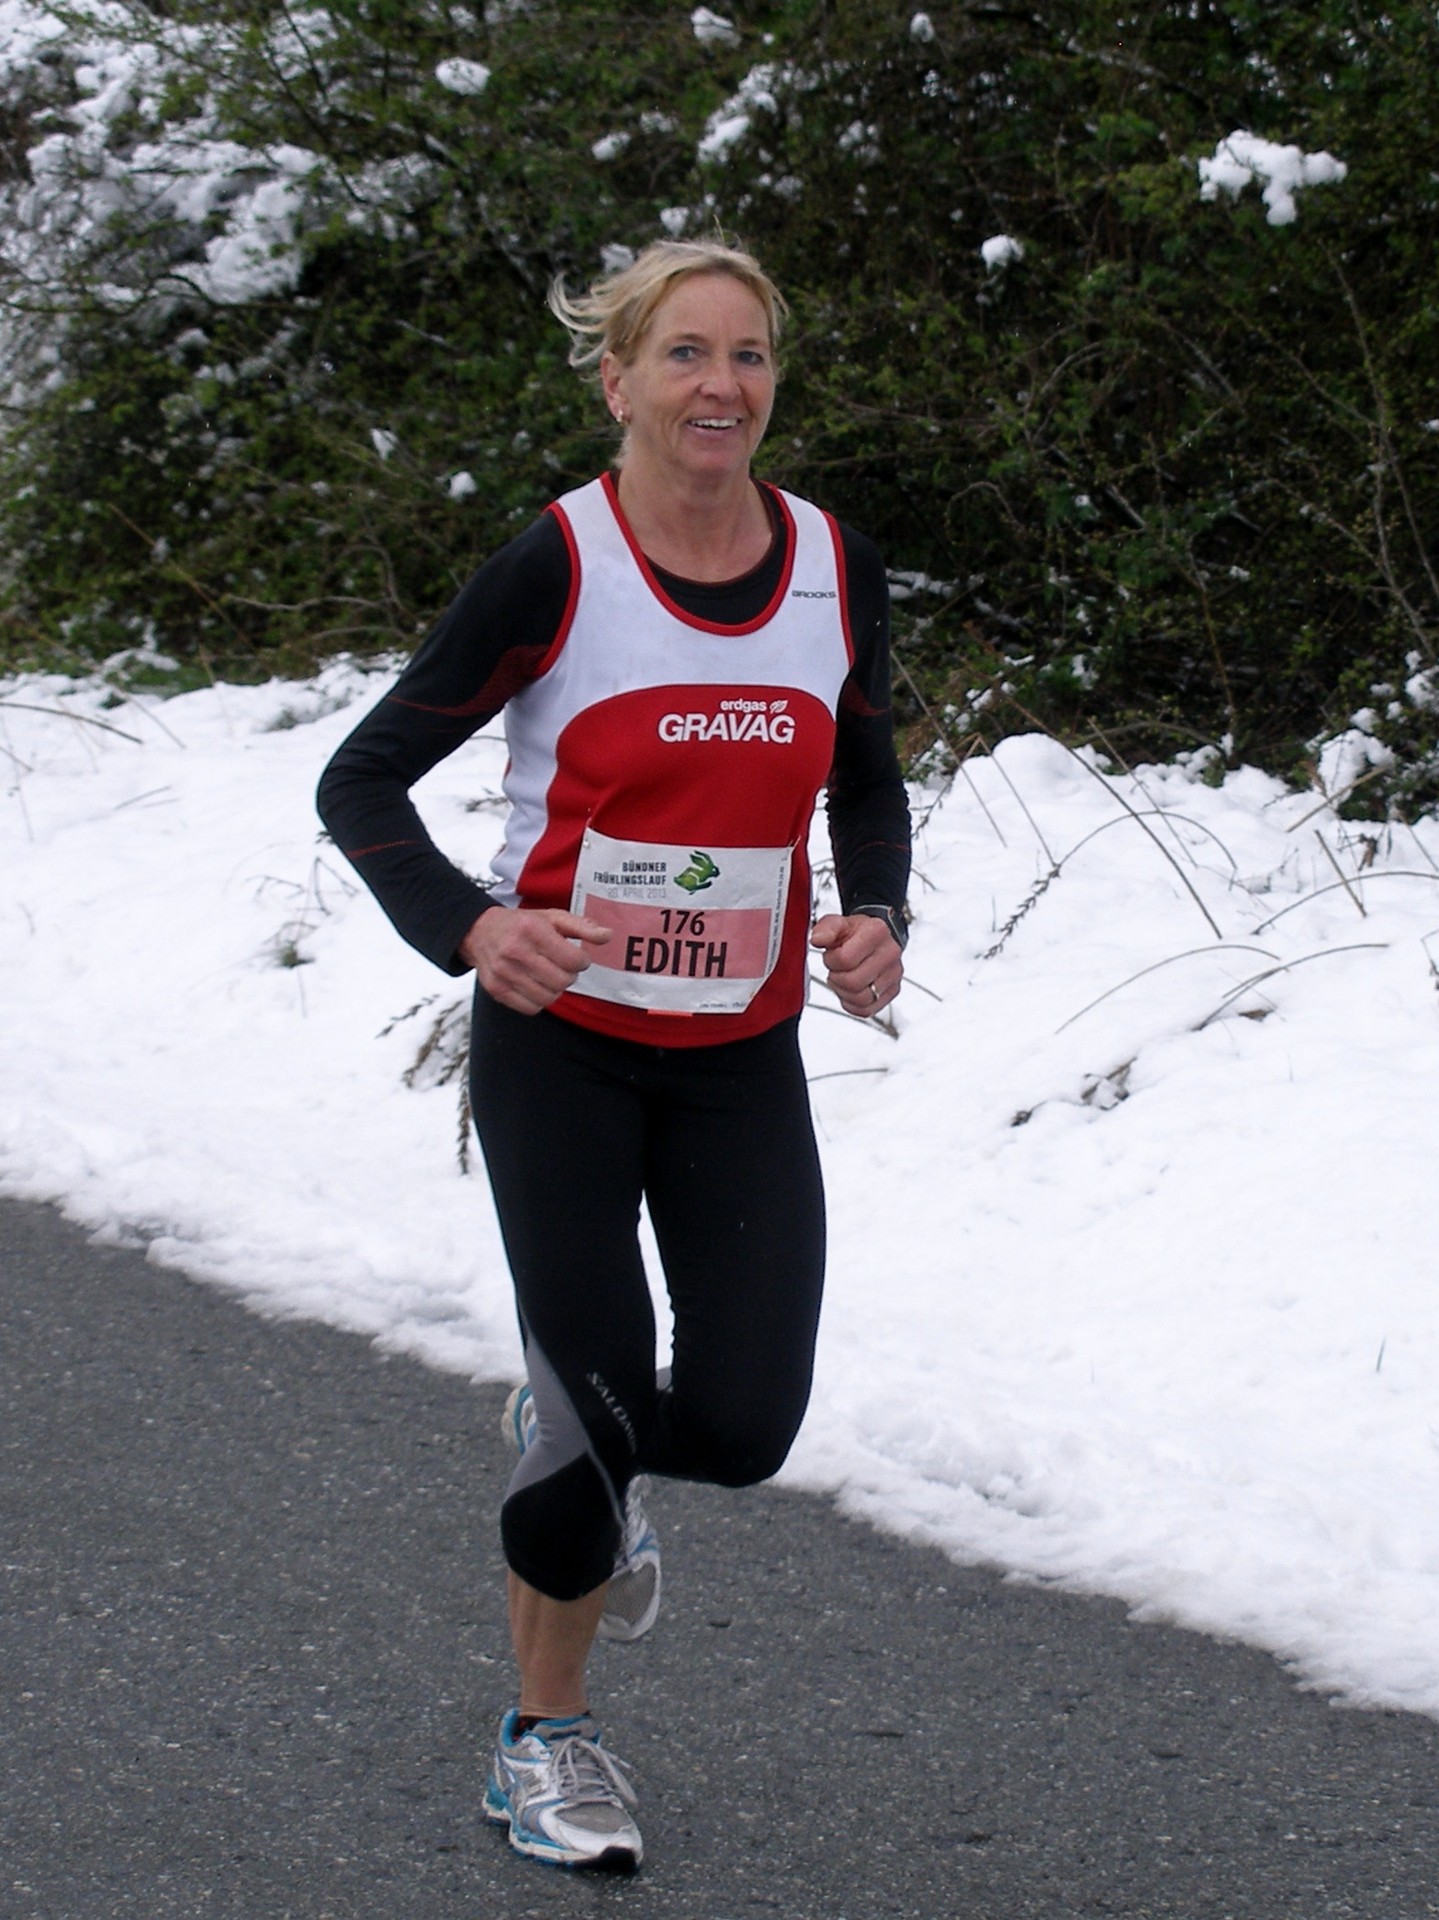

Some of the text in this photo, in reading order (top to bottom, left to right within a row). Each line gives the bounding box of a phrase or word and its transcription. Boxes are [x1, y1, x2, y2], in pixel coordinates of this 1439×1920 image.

[791, 590, 837, 599] BROOKS
[720, 698, 767, 713] erdgas
[658, 713, 796, 744] GRAVAG
[622, 859, 667, 872] BÜNDNER
[593, 871, 667, 886] FRÜHLINGSLAUF
[622, 887, 644, 899] APRIL
[660, 909, 705, 936] 176
[625, 935, 727, 978] EDITH
